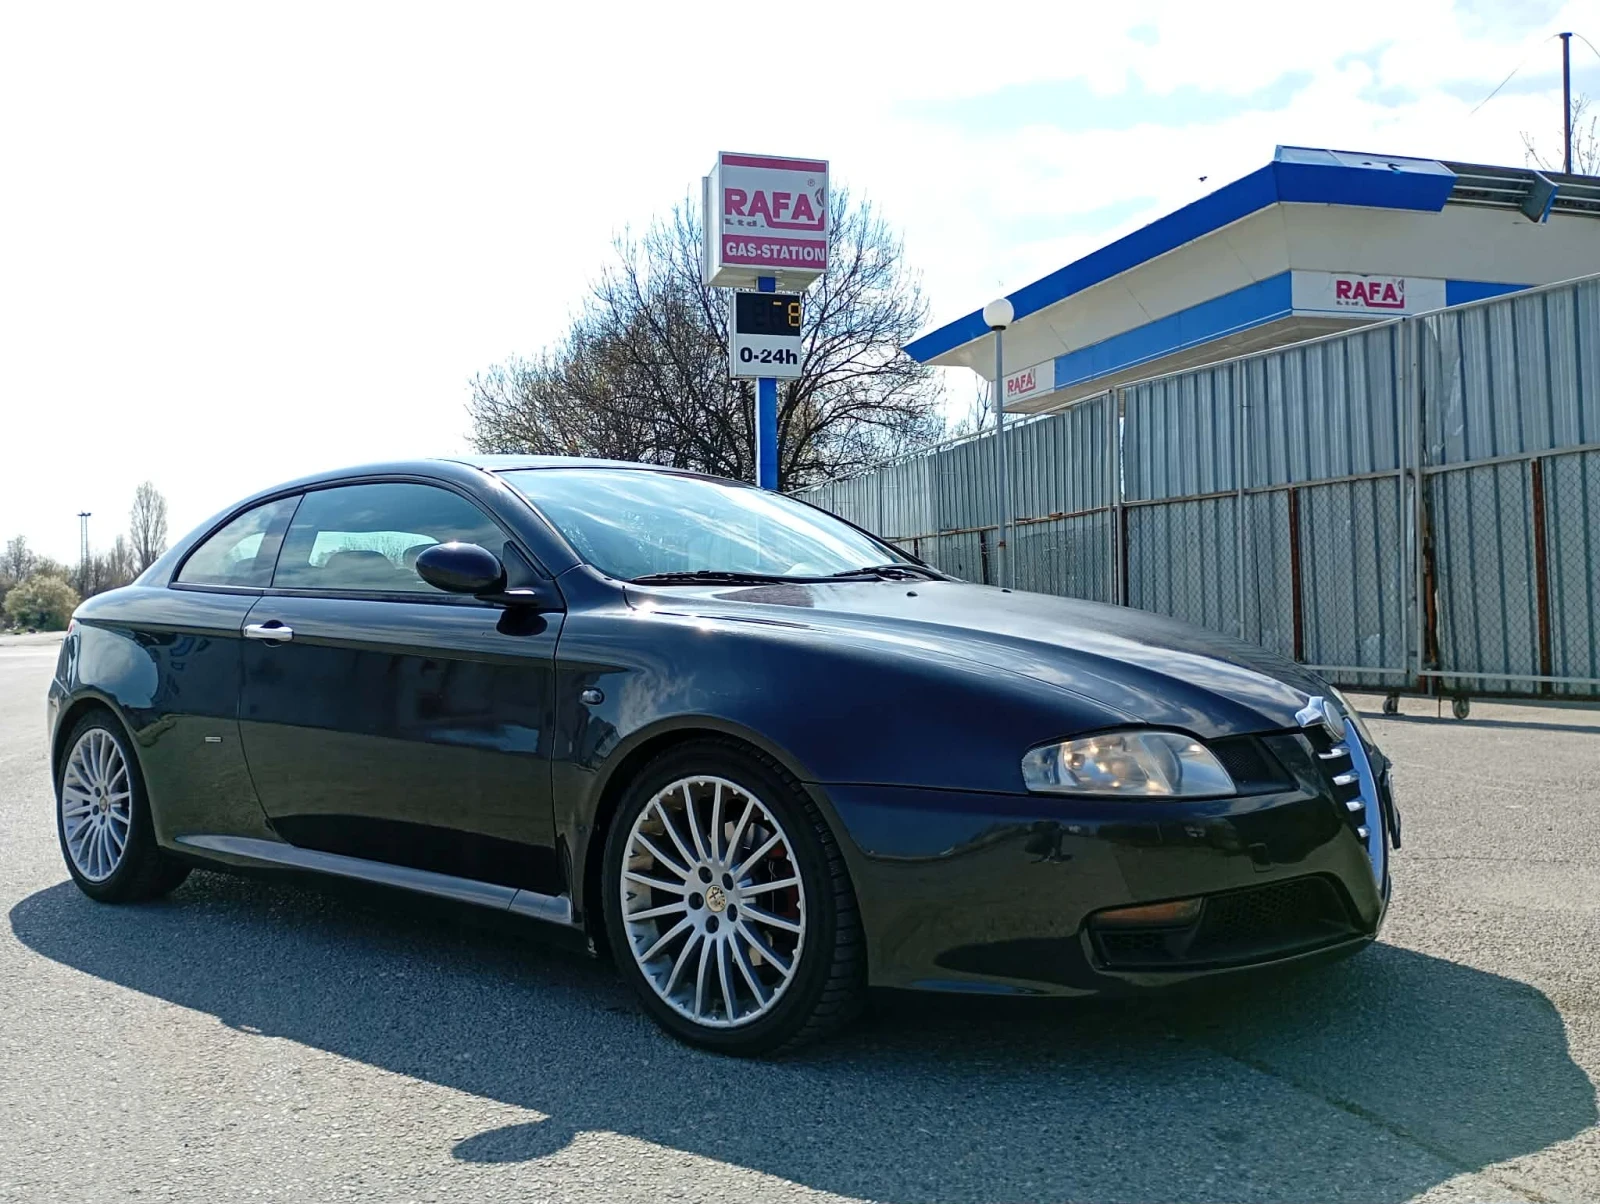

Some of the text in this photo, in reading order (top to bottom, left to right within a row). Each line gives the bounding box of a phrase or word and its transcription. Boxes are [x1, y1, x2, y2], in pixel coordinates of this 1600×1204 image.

[725, 188, 818, 222] RAFA
[726, 241, 825, 261] GAS-STATION
[1336, 280, 1399, 303] RAFA
[740, 347, 798, 365] 0-24h
[1007, 372, 1033, 394] RAFA
